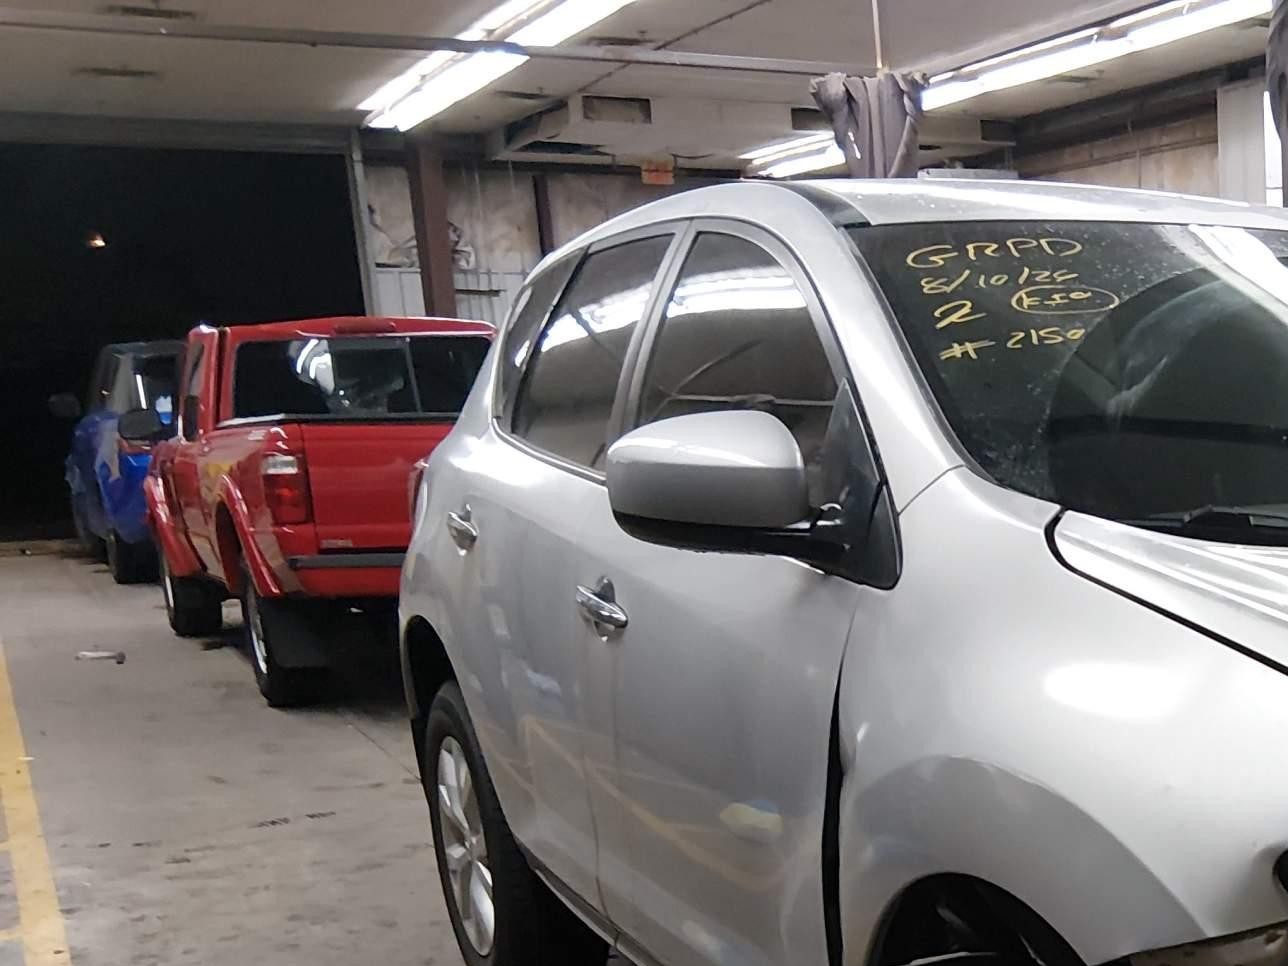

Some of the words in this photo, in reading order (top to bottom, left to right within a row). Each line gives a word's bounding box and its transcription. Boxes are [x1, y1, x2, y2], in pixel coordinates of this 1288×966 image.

[906, 238, 1082, 268] GRPD
[940, 339, 996, 360] #
[1006, 327, 1086, 349] 2150
